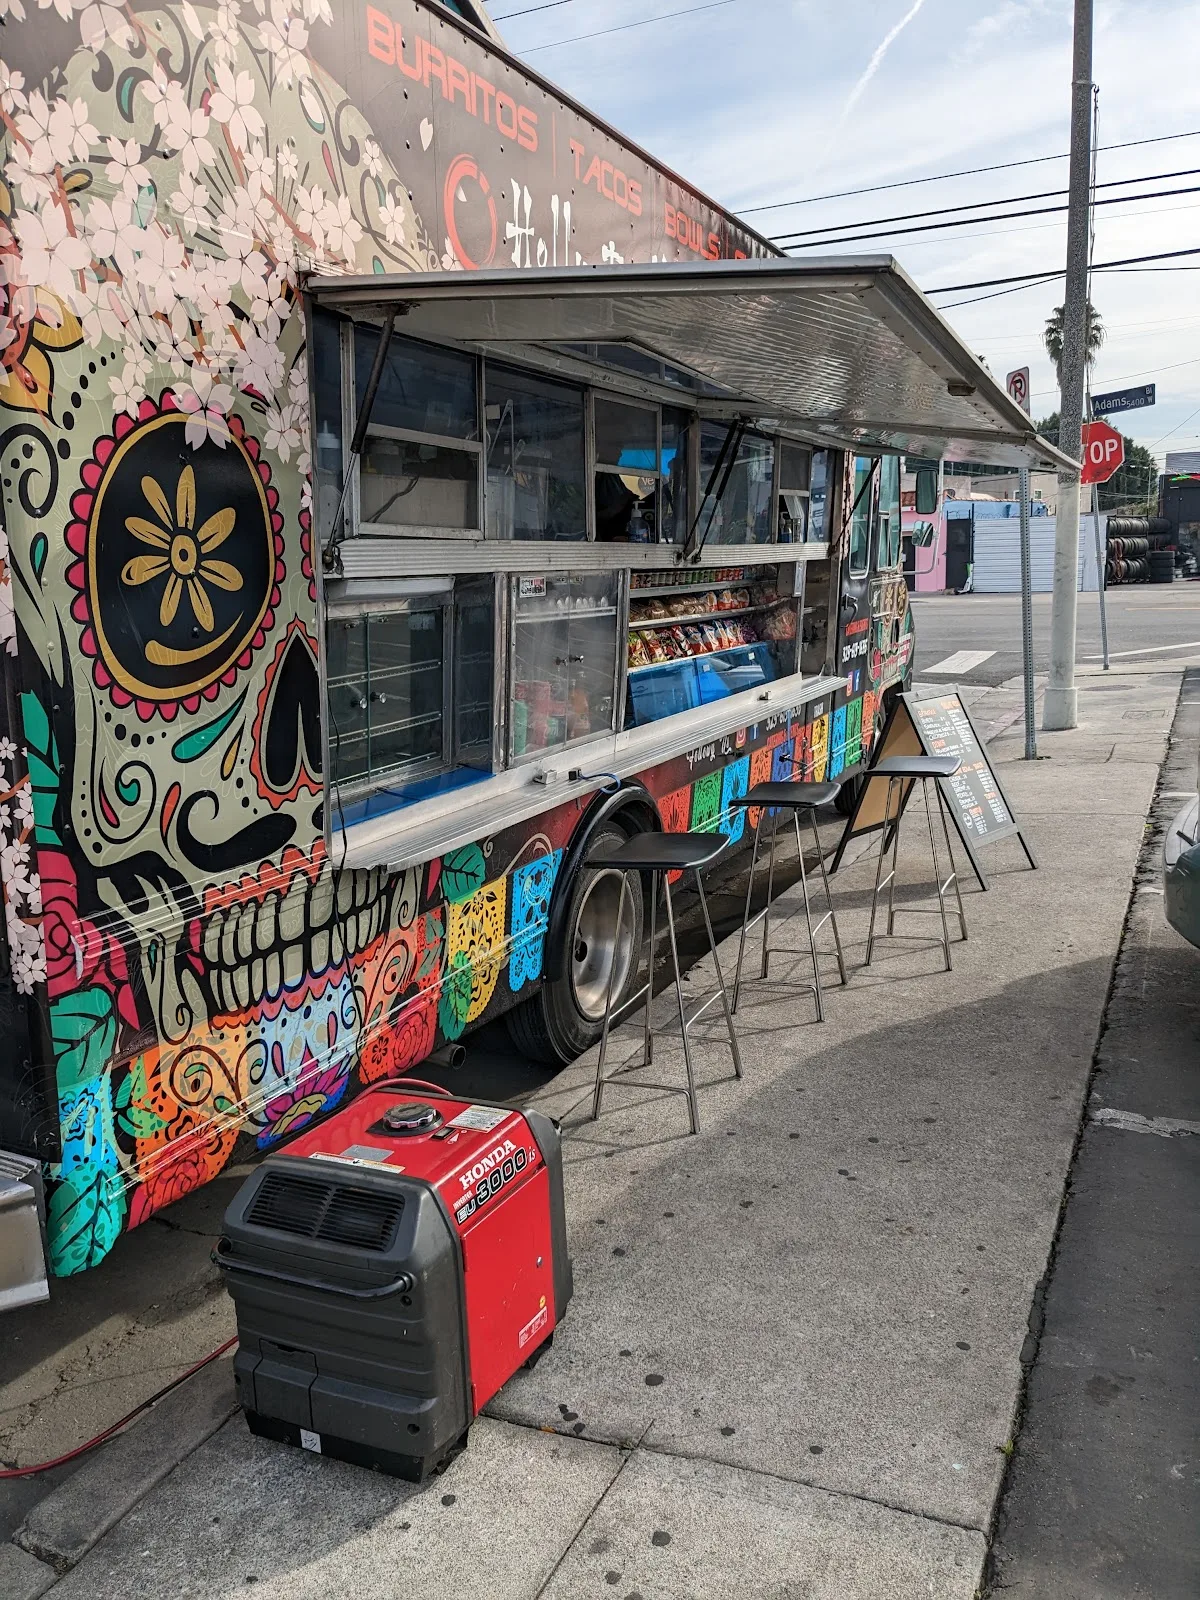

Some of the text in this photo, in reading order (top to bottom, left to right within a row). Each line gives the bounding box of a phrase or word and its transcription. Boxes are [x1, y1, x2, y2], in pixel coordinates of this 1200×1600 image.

[367, 4, 719, 262] BURRITOS TACOS BOWLS
[1094, 397, 1127, 412] Adams
[1126, 397, 1145, 408] 5400
[458, 1139, 517, 1191] HONDA
[452, 1189, 474, 1211] INVERTER
